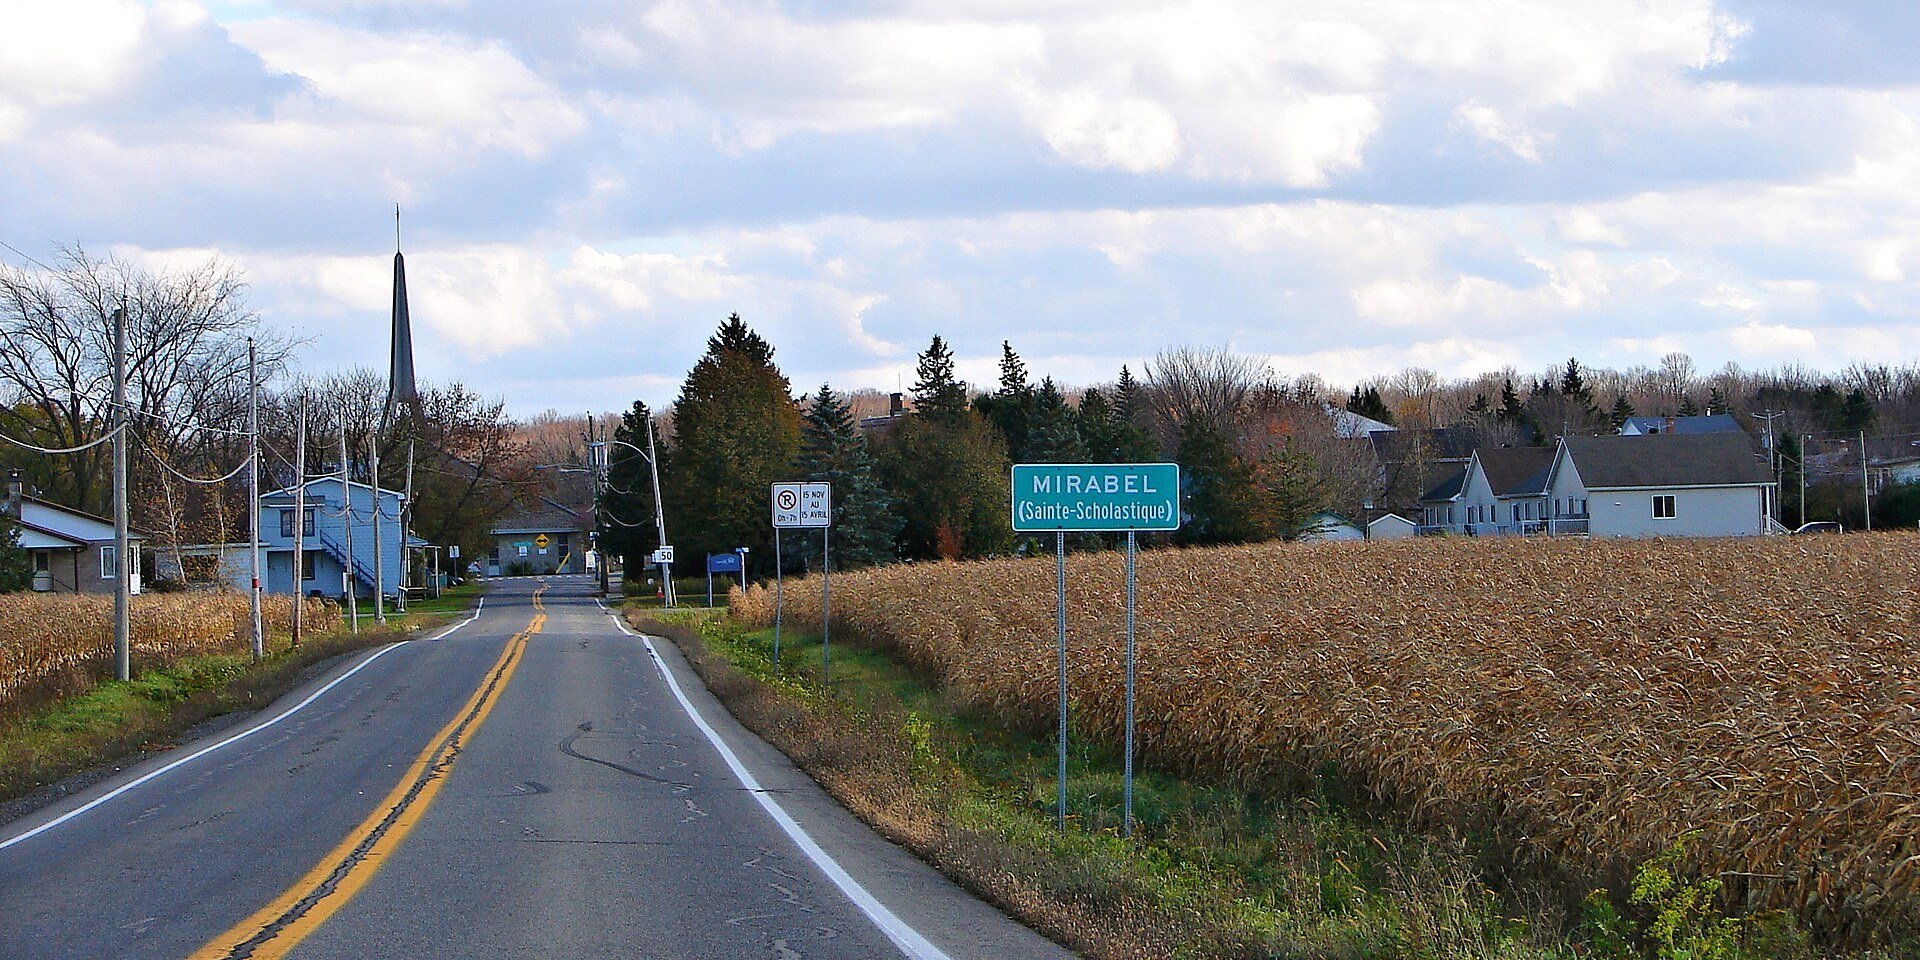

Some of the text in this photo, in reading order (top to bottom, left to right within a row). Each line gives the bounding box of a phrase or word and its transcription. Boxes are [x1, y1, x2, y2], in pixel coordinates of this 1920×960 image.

[1033, 475, 1157, 493] MIRABEL
[803, 491, 825, 499] 15 NOV
[810, 501, 820, 509] AU
[802, 510, 828, 519] 15 AVRIL
[1018, 499, 1173, 523] (Sainte-Scholastique)
[661, 551, 672, 561] 50
